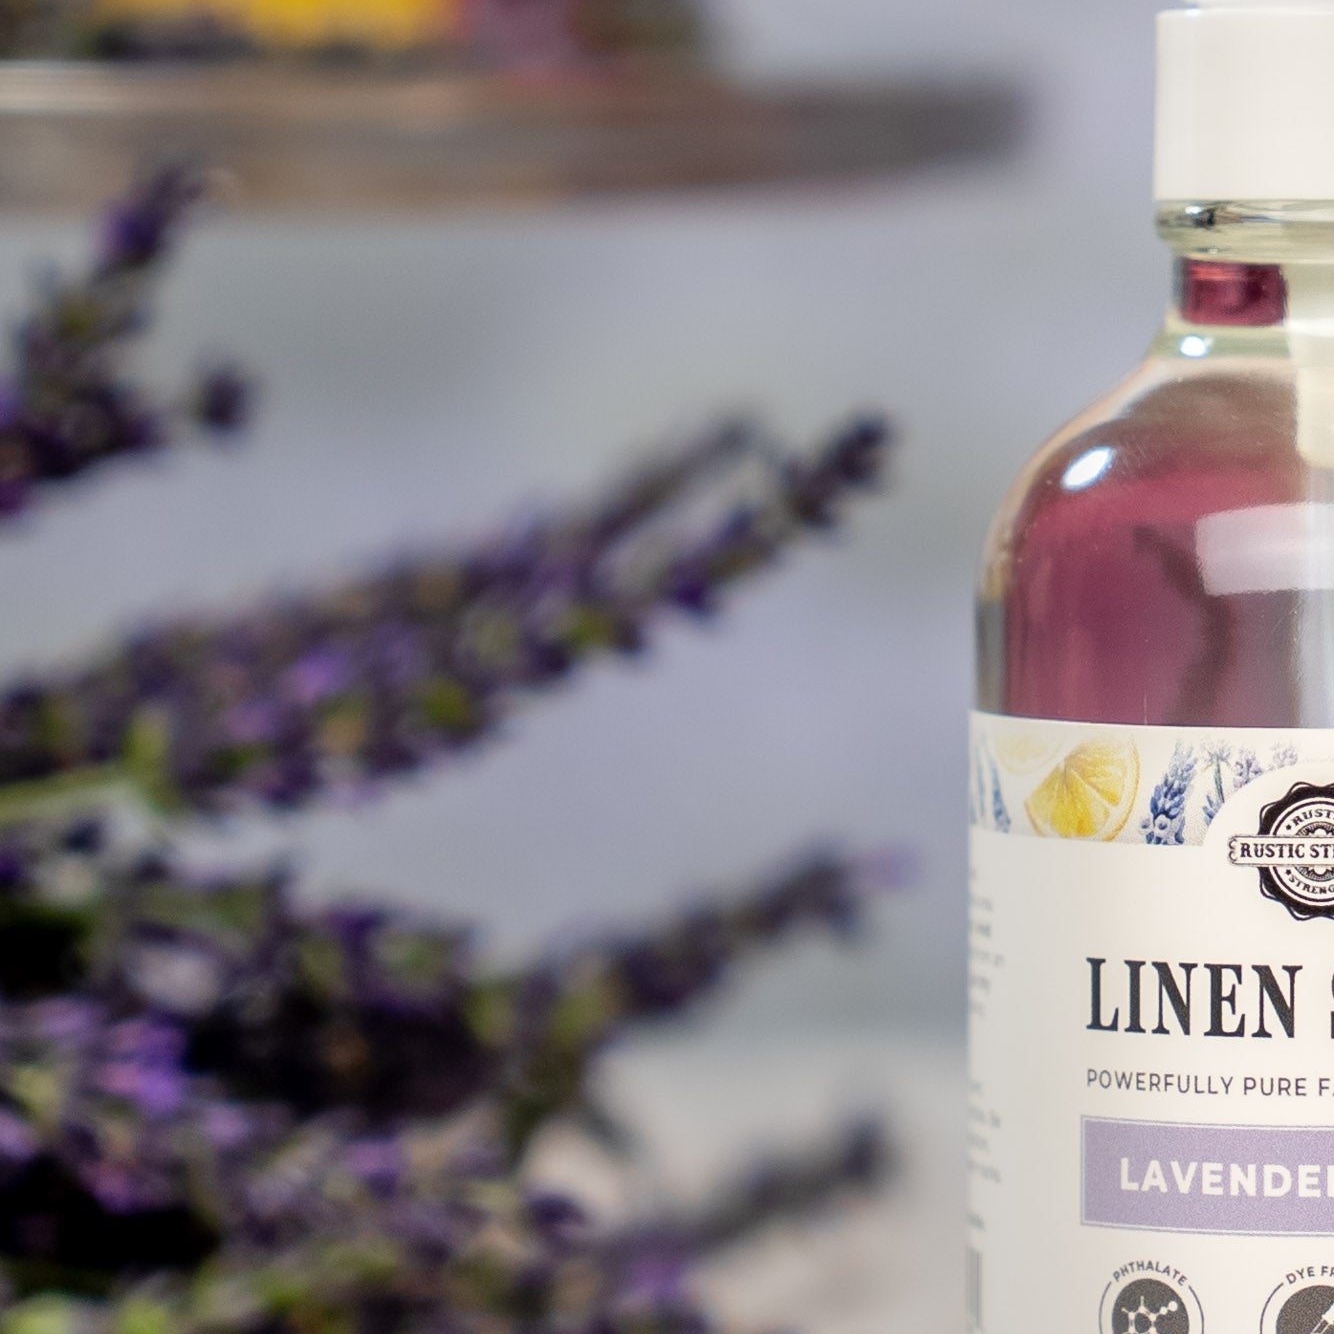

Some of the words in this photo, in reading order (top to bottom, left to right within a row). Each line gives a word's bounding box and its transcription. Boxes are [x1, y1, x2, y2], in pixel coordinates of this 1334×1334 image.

[1240, 842, 1305, 859] RUSTIC
[1085, 956, 1303, 1040] LINEN
[1086, 1068, 1235, 1096] POWERFULLY
[1243, 1077, 1308, 1097] PURE
[1112, 1260, 1188, 1287] PHTHALATE
[1286, 1266, 1316, 1285] DYE
